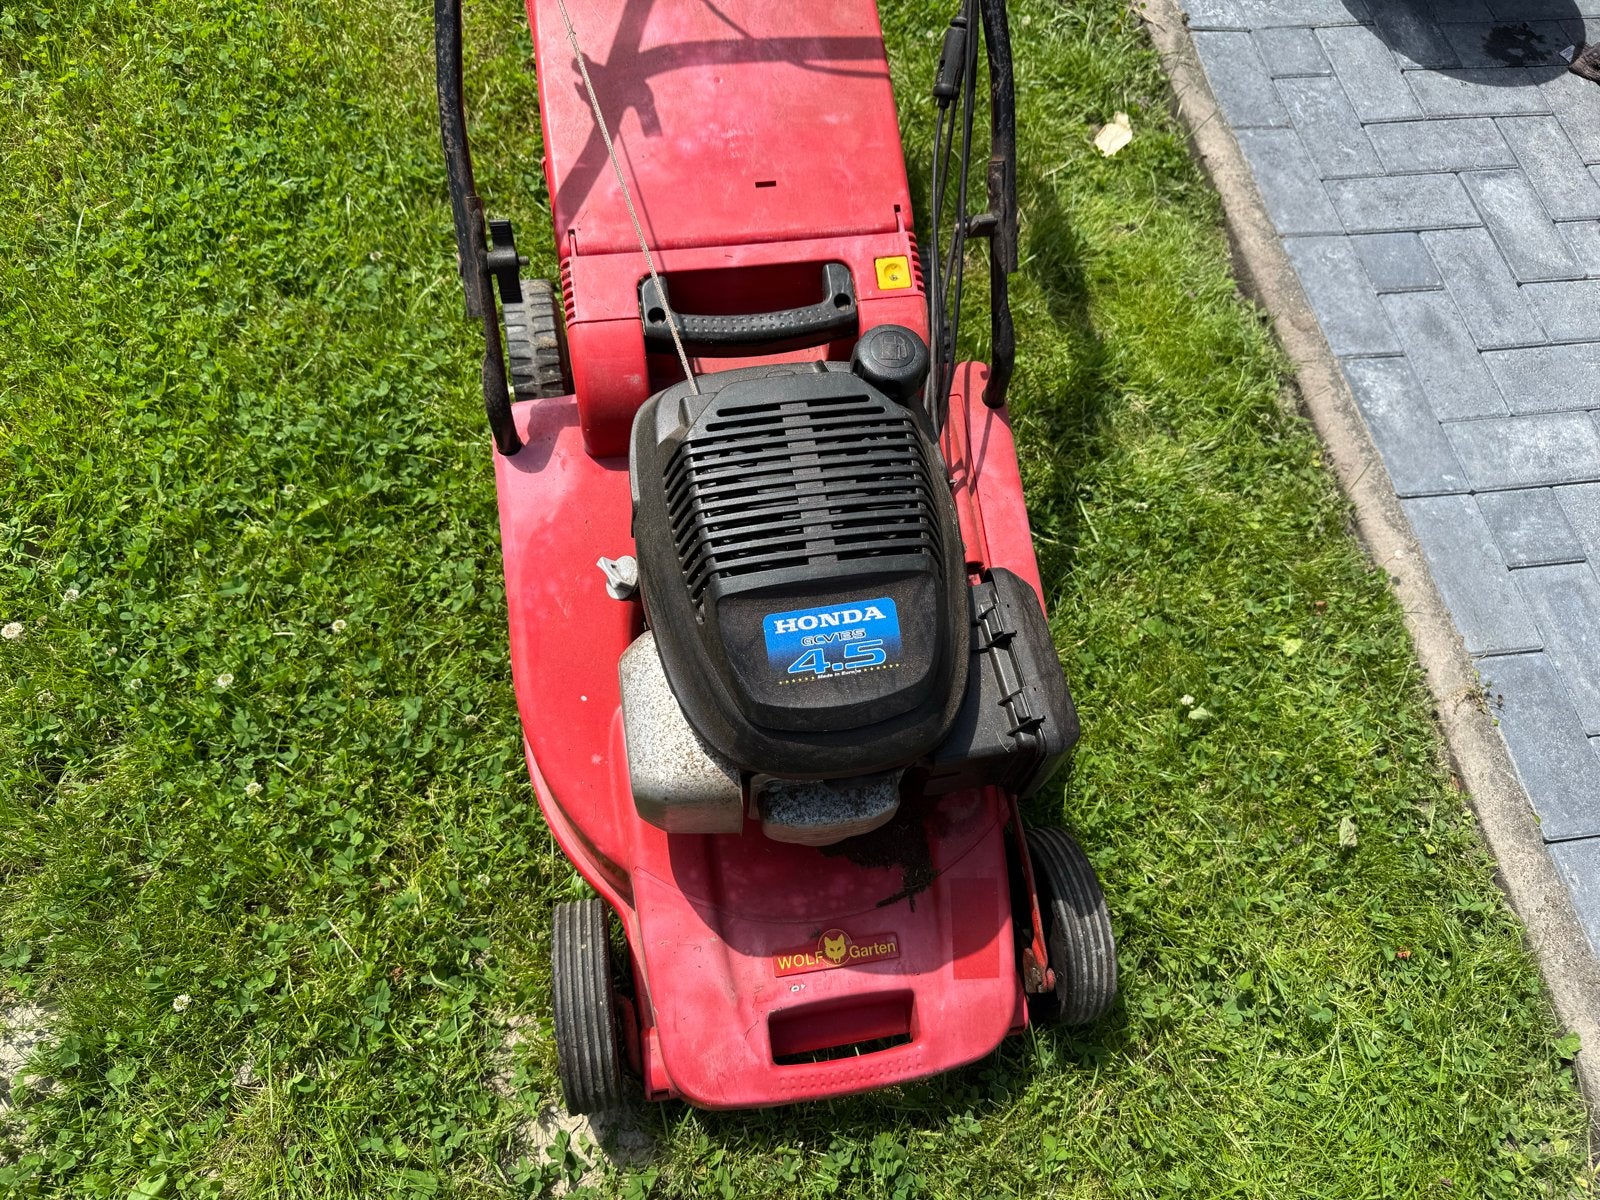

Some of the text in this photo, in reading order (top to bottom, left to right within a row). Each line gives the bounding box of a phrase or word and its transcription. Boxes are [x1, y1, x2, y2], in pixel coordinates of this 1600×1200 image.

[774, 606, 886, 634] HONDA
[801, 628, 867, 646] GCV135
[788, 639, 887, 675] 4.5
[778, 942, 896, 970] WOLF Garten
